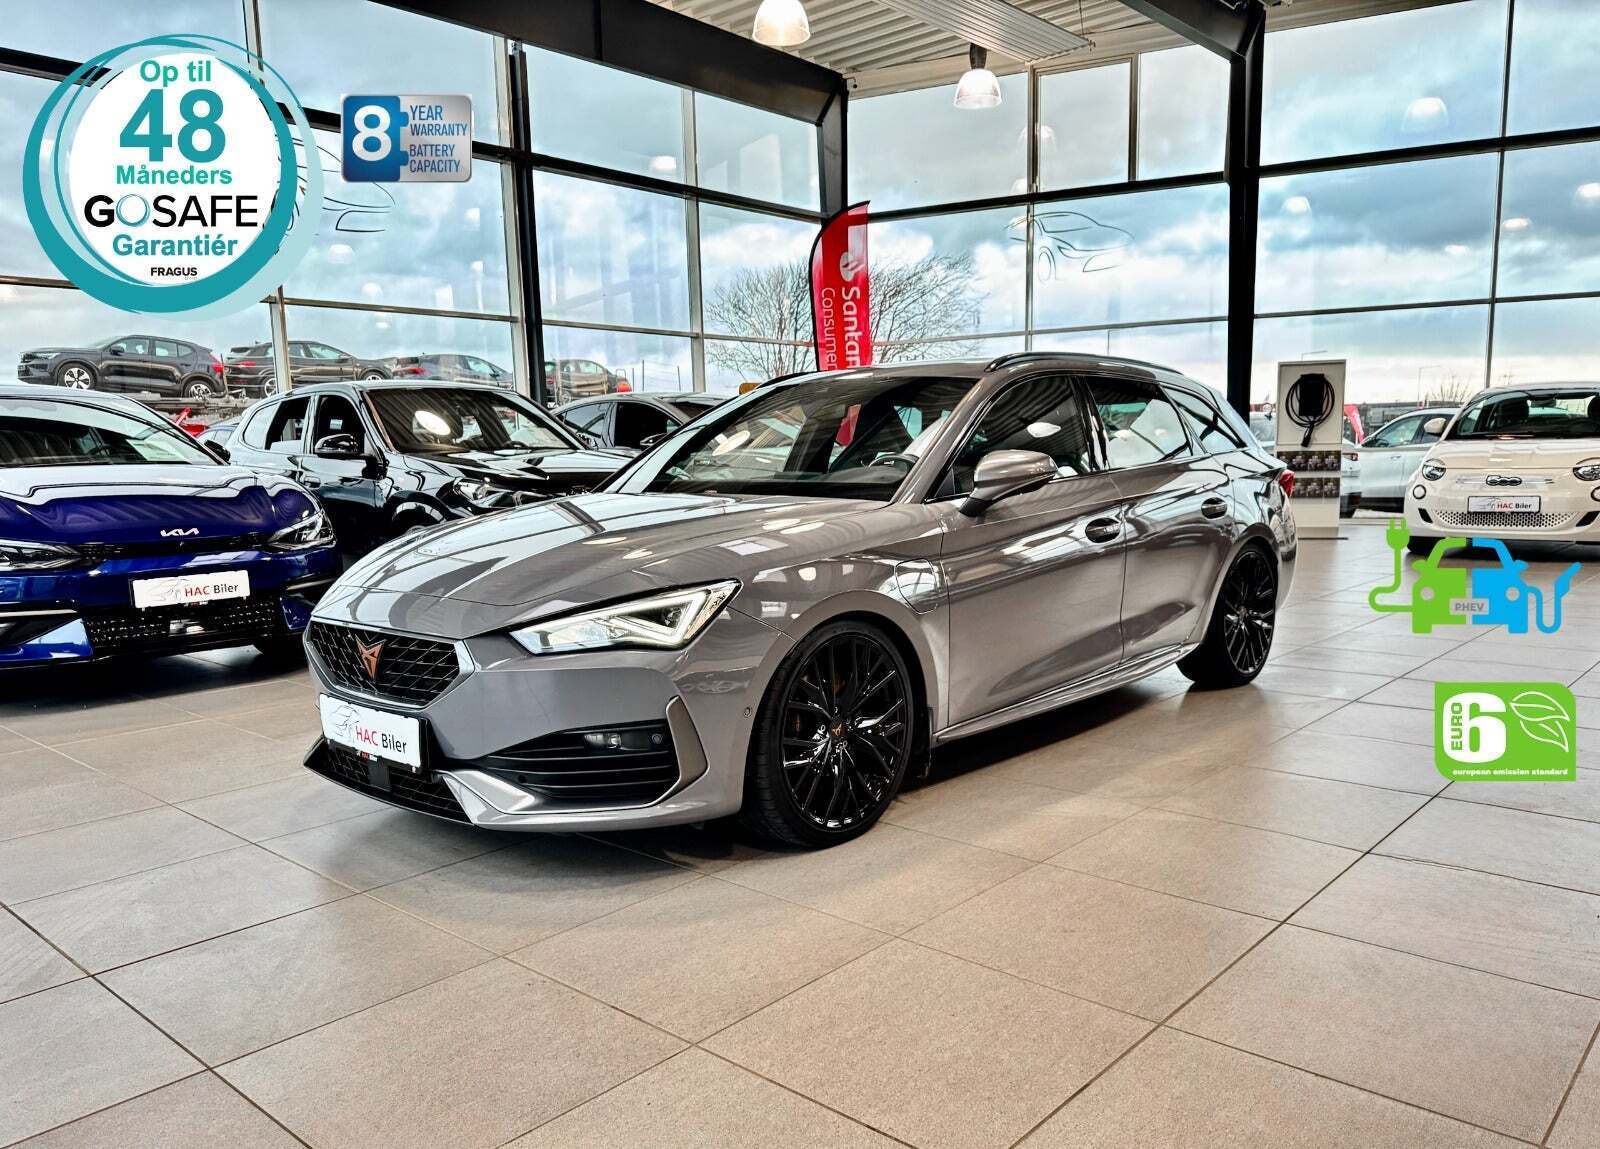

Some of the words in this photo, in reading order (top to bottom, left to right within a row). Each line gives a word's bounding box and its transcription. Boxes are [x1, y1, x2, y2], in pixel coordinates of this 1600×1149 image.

[1497, 502, 1514, 510] HAC
[1515, 501, 1533, 510] Biler
[184, 585, 211, 598] HAC
[213, 583, 239, 595] Biler
[355, 725, 379, 747] HAC
[381, 733, 407, 755] Biler
